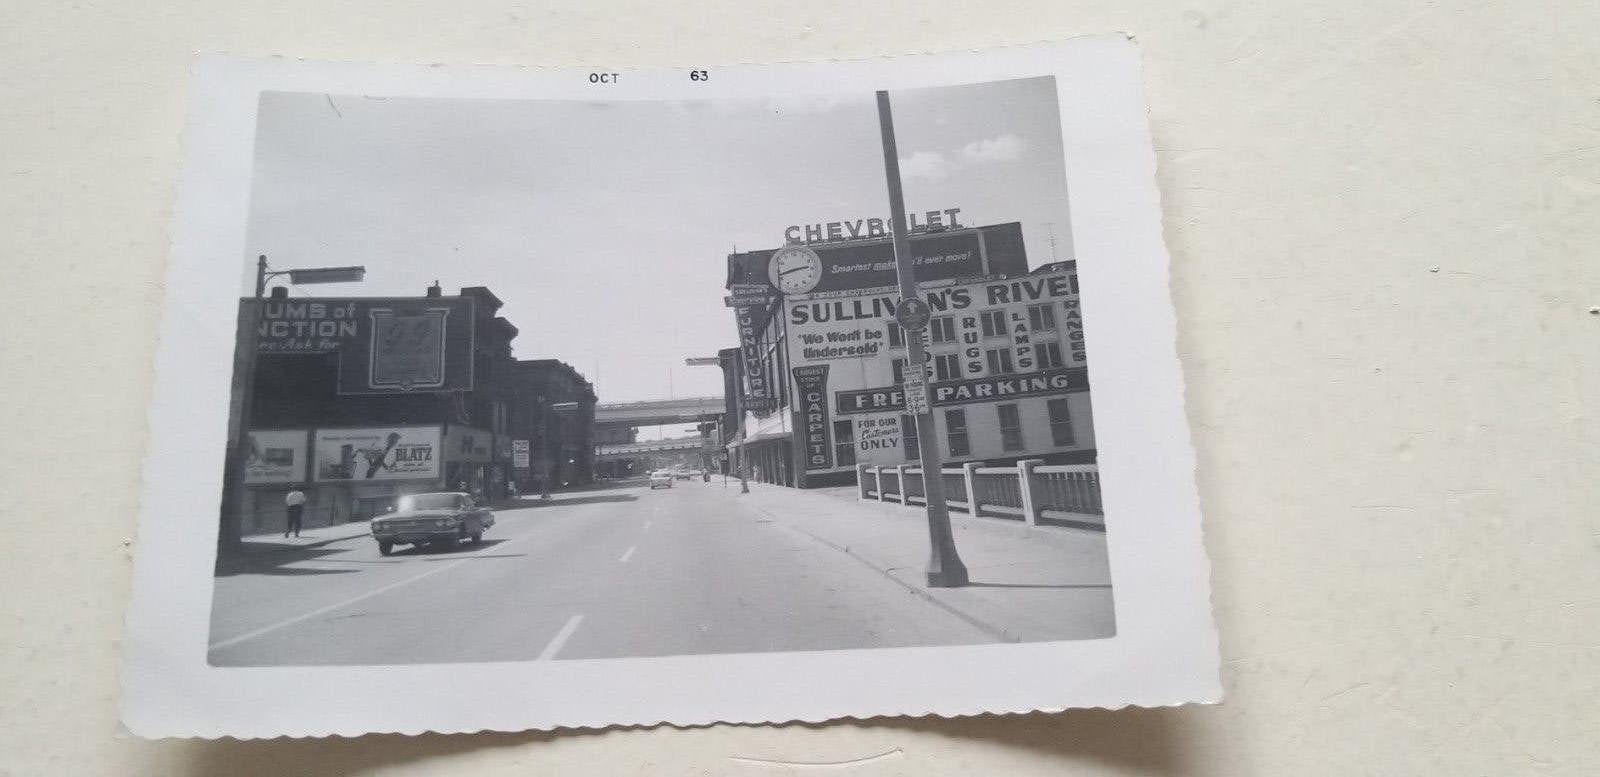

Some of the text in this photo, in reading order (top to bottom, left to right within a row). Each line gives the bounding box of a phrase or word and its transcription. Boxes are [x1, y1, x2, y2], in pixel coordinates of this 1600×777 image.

[589, 70, 708, 83] OCT 63
[784, 208, 961, 242] CHEVRLET
[832, 263, 871, 274] Smartest
[925, 255, 944, 264] ever
[258, 302, 356, 319] UMS of
[791, 288, 972, 325] SULLIVN'S
[864, 328, 883, 340] be
[962, 317, 984, 374] RUGS
[1012, 312, 1034, 368] LAMPS
[738, 306, 766, 398] FURNITURE
[856, 391, 903, 408] FRE
[937, 374, 1069, 401] PARKING
[807, 392, 826, 464] CARPETS
[858, 417, 897, 429] FOR OUR
[395, 446, 433, 461] BLATZ
[861, 438, 898, 450] ONLY
